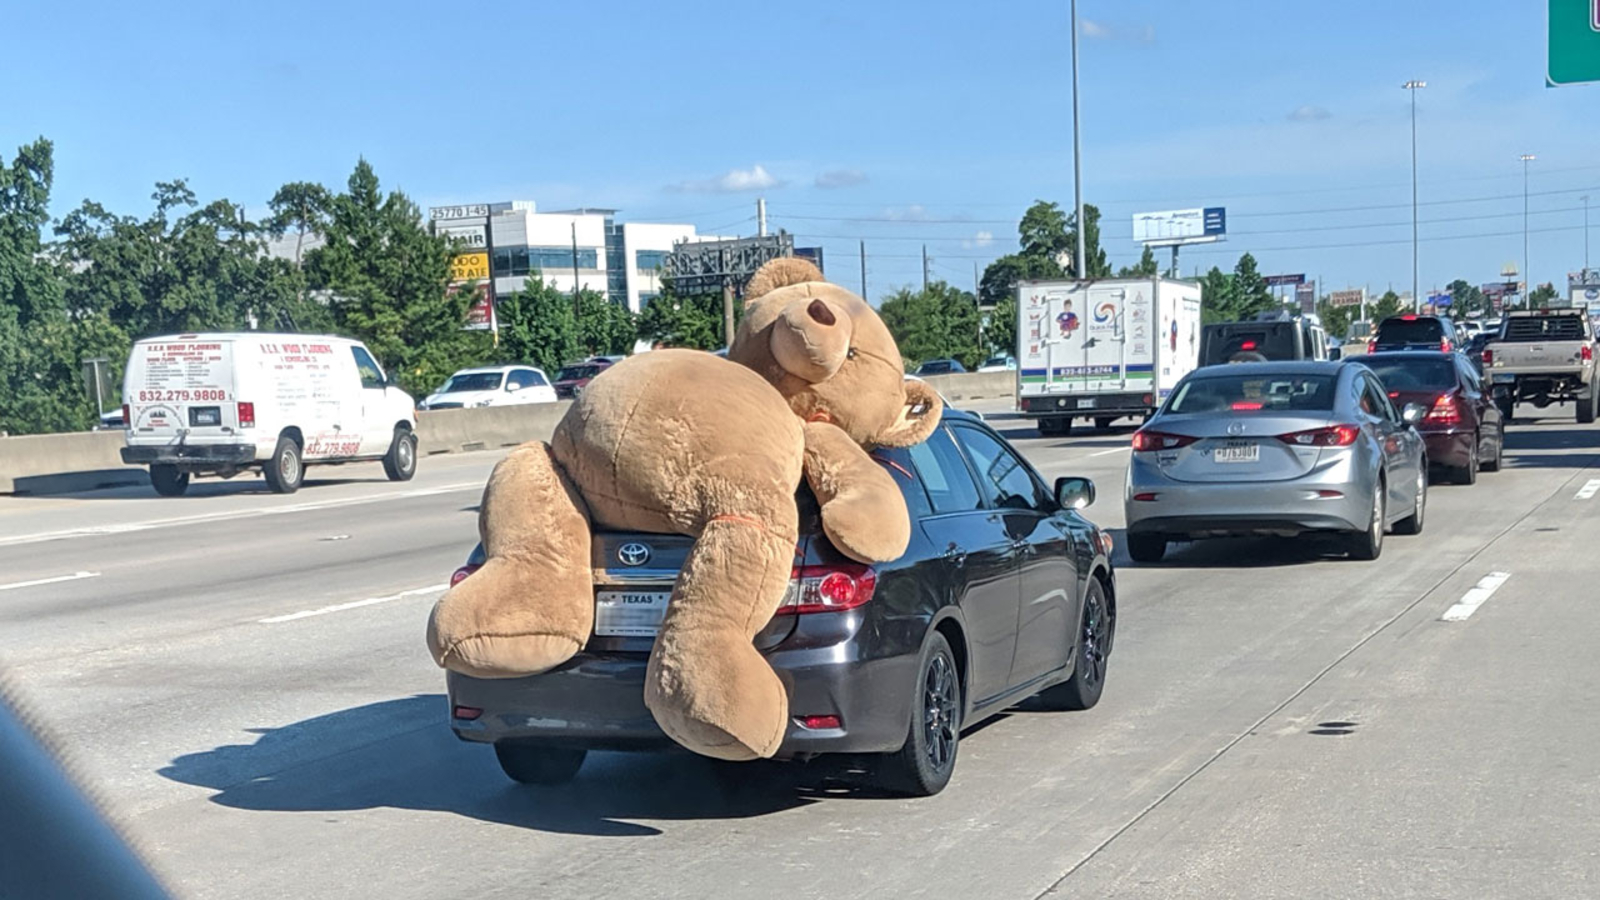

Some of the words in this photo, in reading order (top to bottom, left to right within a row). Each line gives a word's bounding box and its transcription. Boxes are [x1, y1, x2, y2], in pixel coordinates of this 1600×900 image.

[432, 208, 463, 219] 25770
[466, 206, 487, 217] I-45
[447, 234, 484, 245] HAIR
[140, 389, 226, 401] 832.279.9808
[621, 595, 653, 604] TEXAS
